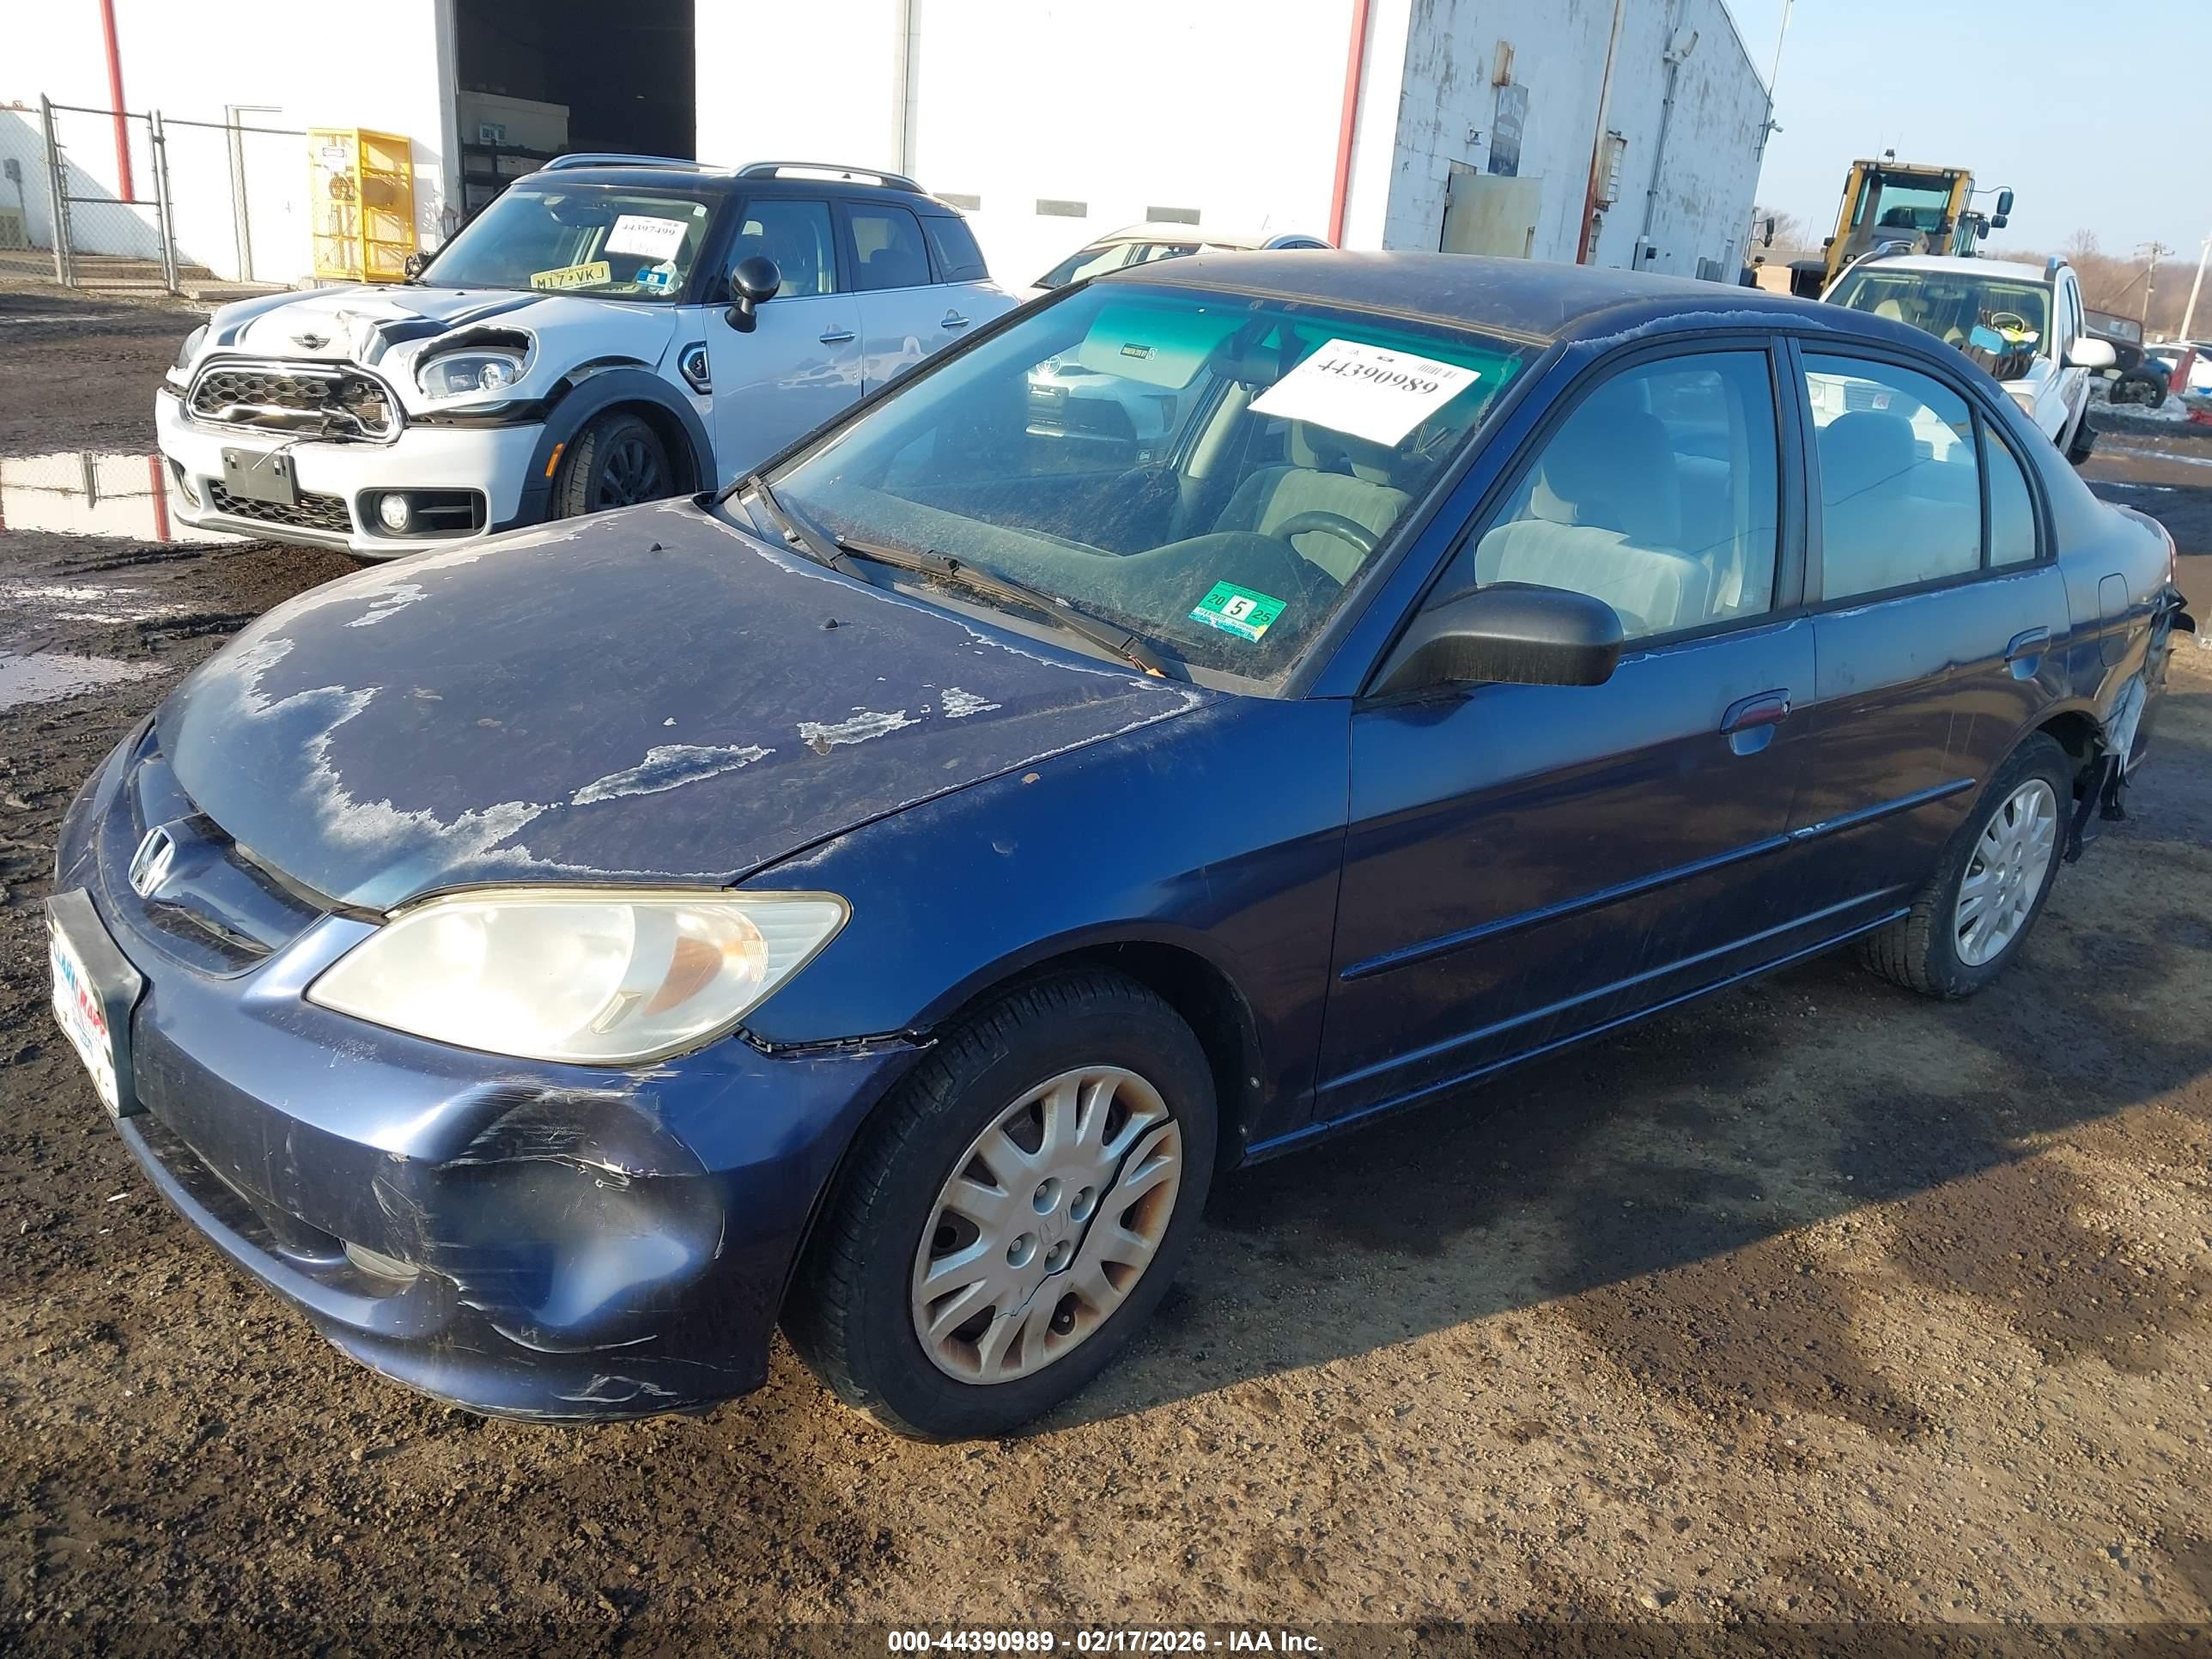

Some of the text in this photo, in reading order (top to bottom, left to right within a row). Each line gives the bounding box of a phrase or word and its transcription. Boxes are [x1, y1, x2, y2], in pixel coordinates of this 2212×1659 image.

[622, 223, 676, 235] 44397499
[1317, 358, 1440, 395] 44390989
[1207, 593, 1226, 605] 20
[1230, 600, 1248, 616] 5
[1252, 610, 1273, 623] 25
